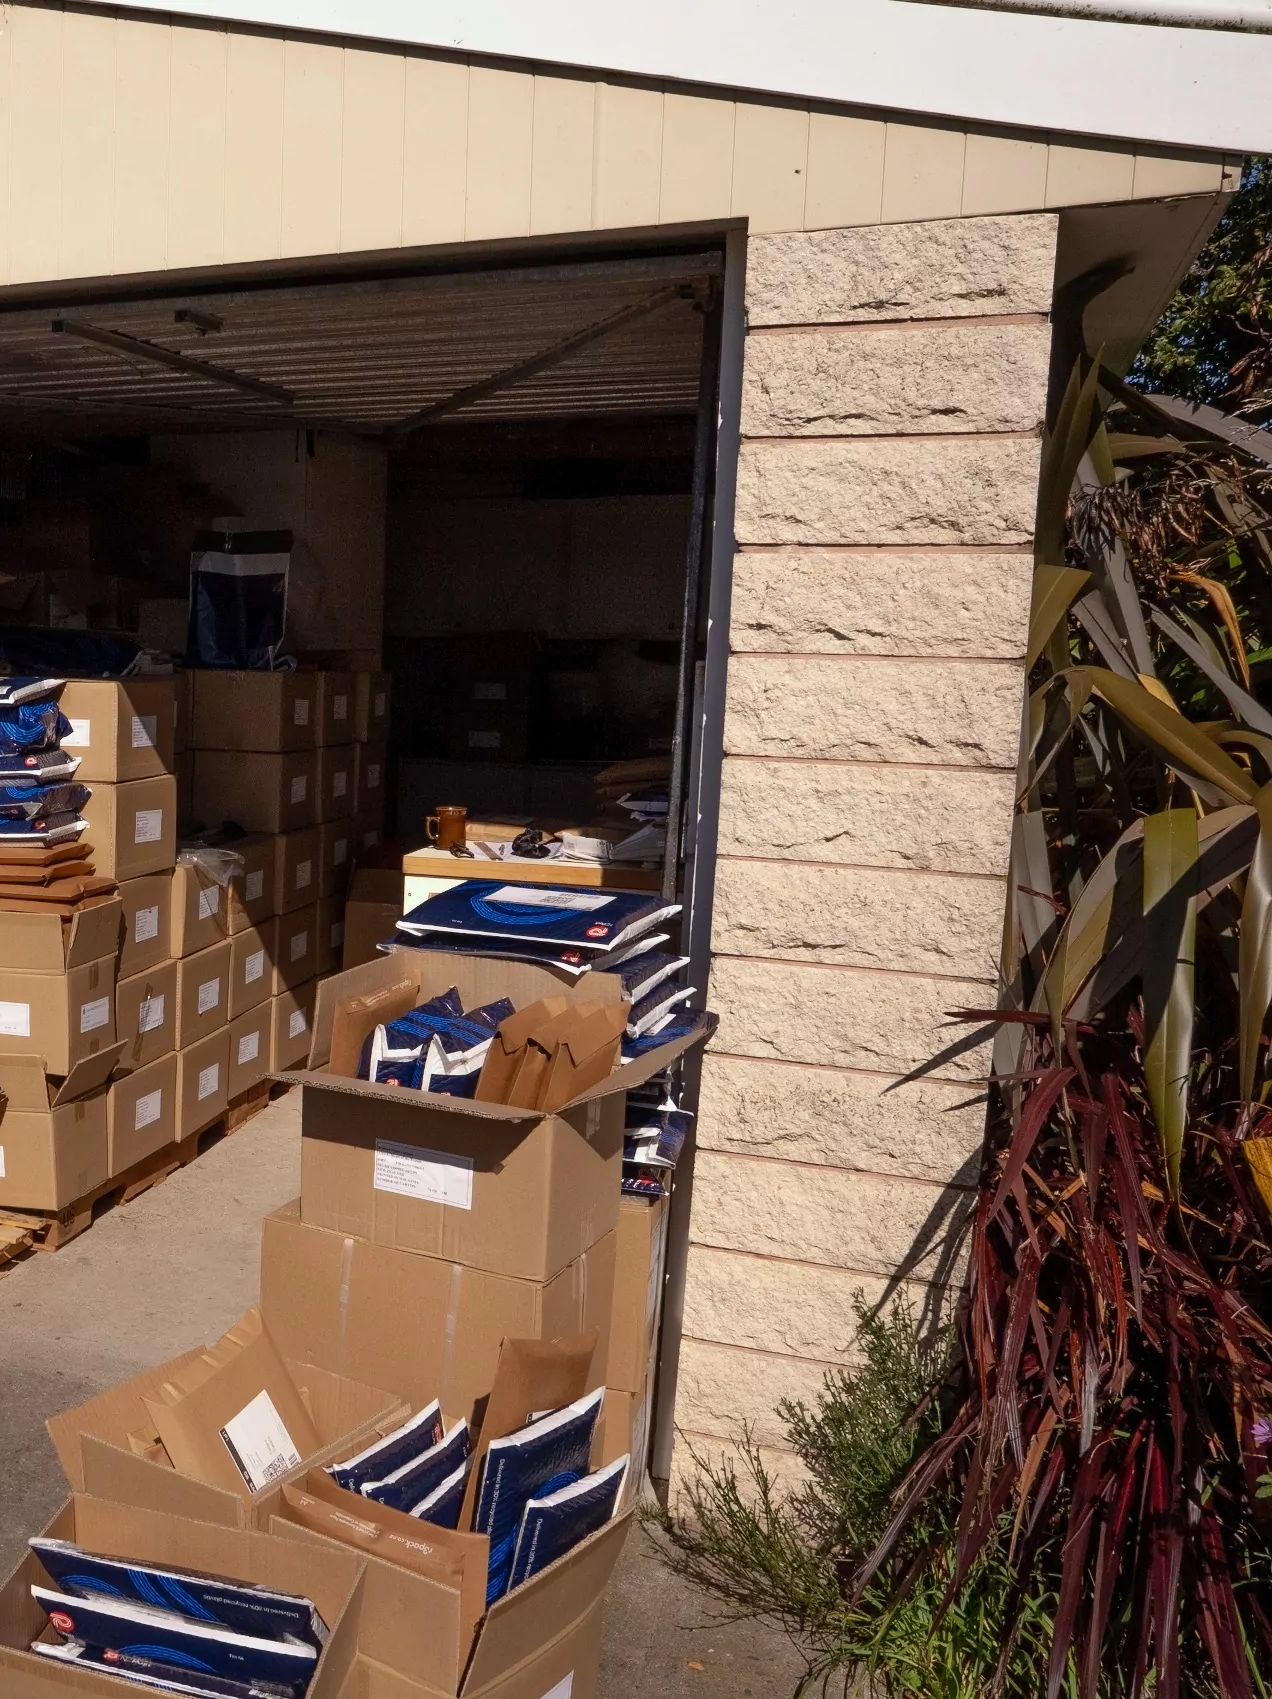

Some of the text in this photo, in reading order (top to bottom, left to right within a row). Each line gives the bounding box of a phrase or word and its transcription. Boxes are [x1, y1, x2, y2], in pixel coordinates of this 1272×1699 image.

[496, 1458, 506, 1484] Delivered
[492, 1489, 500, 1502] 30%
[488, 1502, 497, 1525] recycled
[532, 1518, 543, 1545] Delivered
[388, 1533, 434, 1555] r3pack.co.nz
[527, 1551, 536, 1564] 30%
[203, 1594, 223, 1604] plastic
[223, 1598, 249, 1609] recycled
[249, 1604, 263, 1612] 30%
[270, 1608, 299, 1619] Delivered
